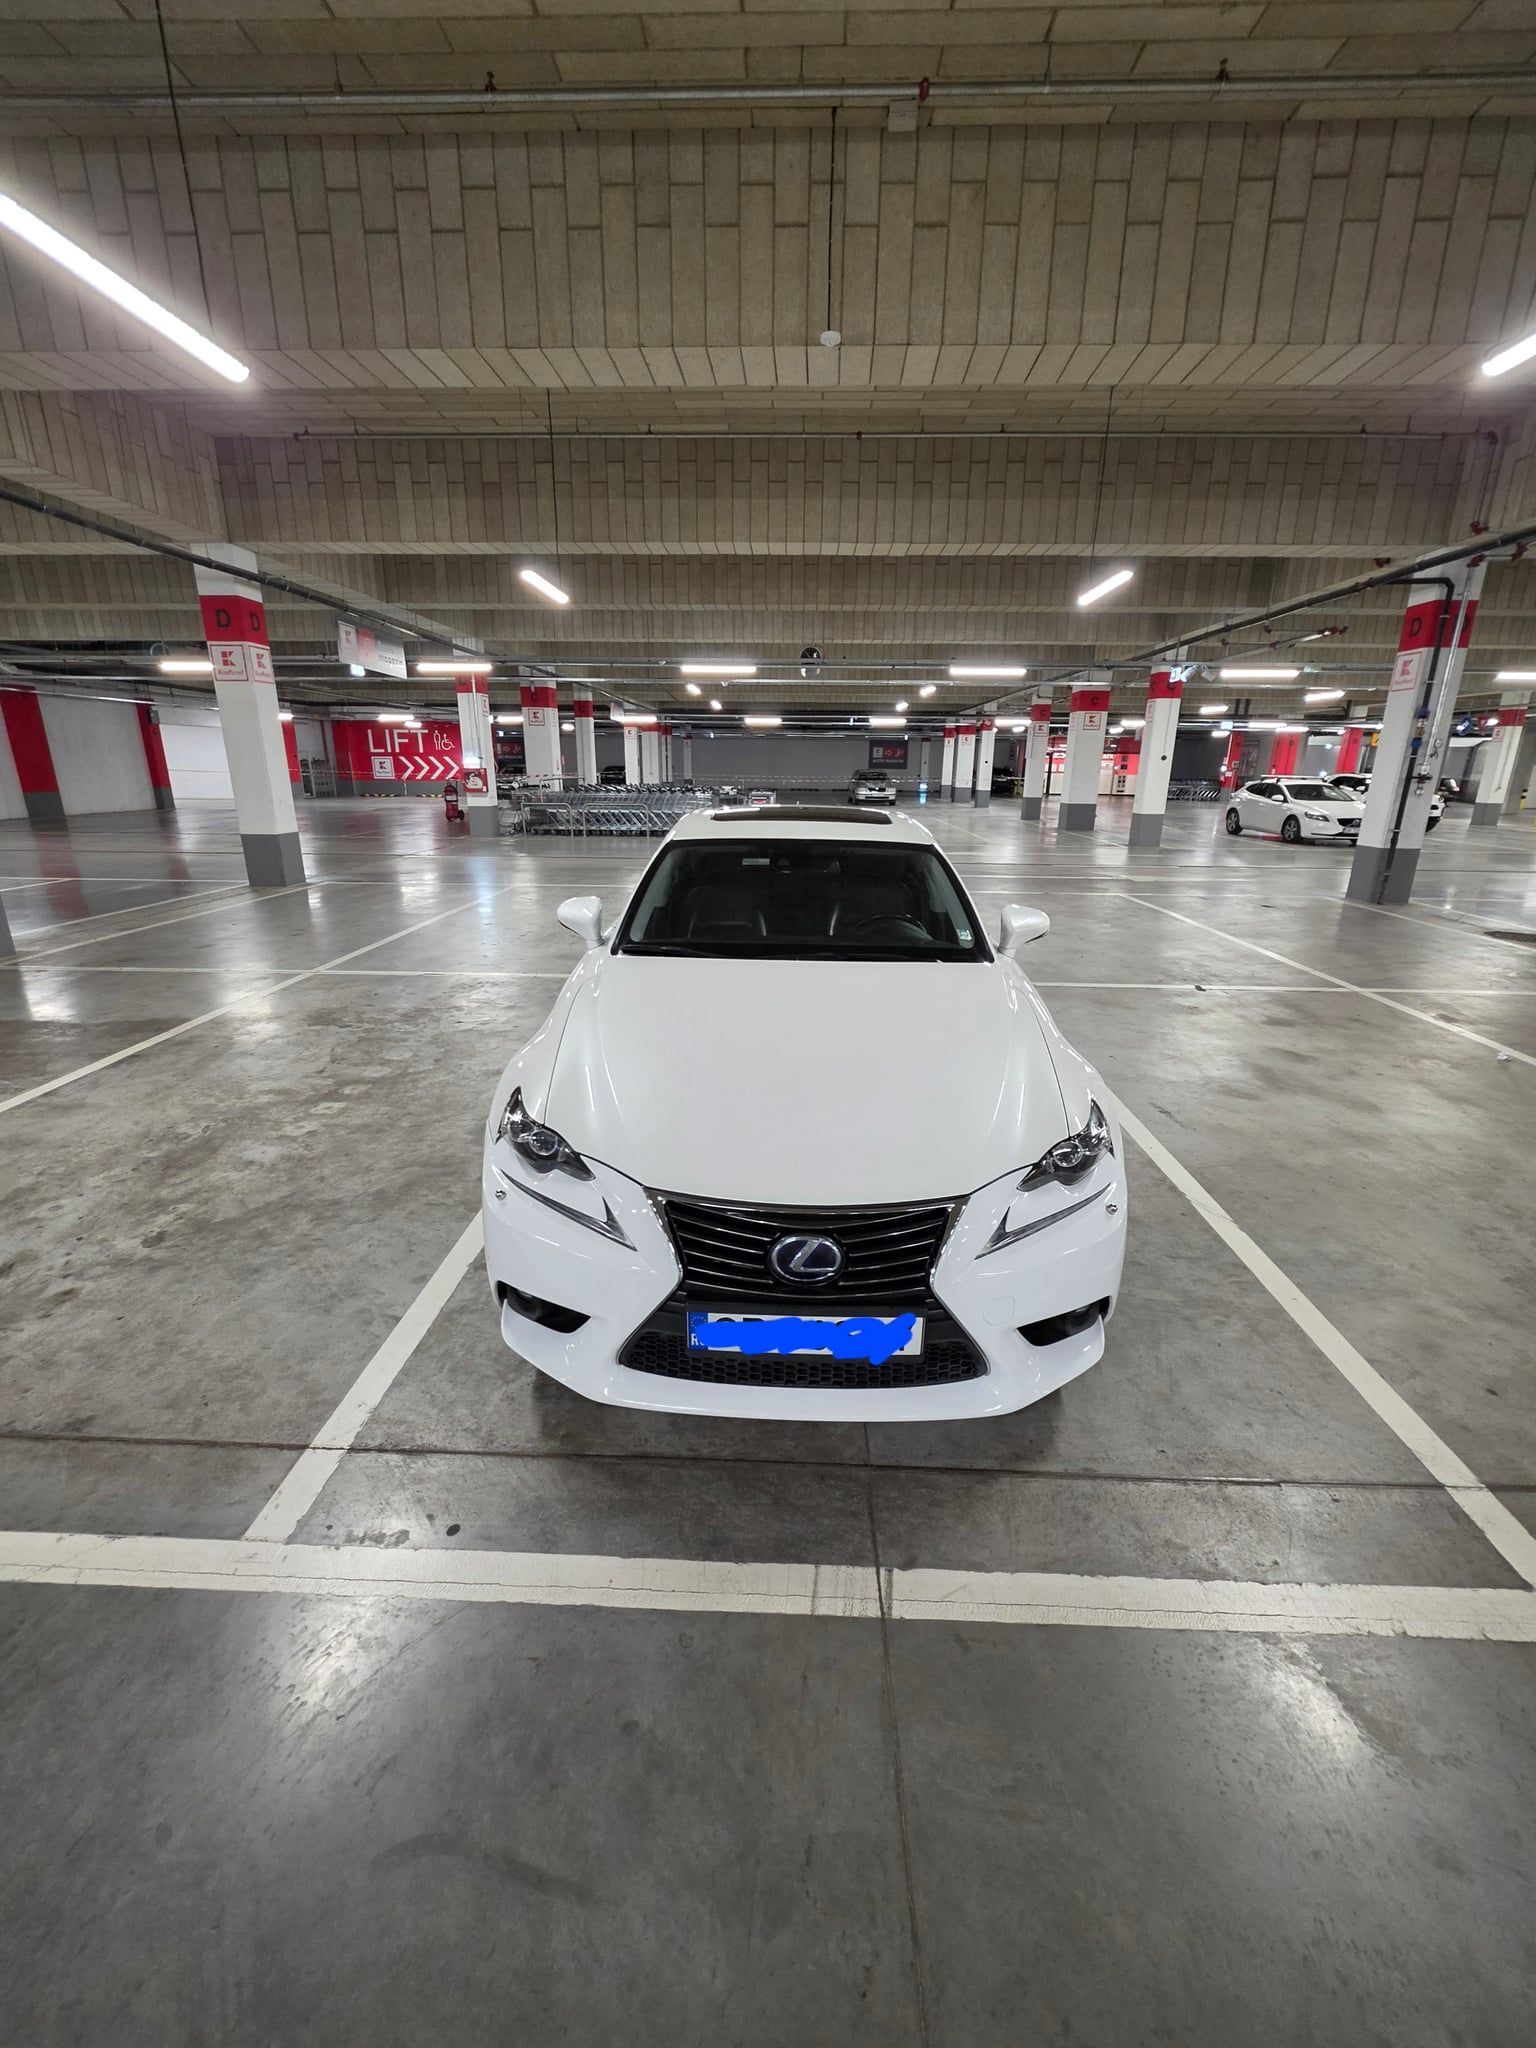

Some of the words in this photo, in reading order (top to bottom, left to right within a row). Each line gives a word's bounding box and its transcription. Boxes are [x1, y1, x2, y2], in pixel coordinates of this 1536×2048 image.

[215, 608, 231, 628] D
[249, 612, 260, 632] D
[1409, 617, 1422, 637] D
[367, 729, 429, 753] LIFT
[691, 1333, 706, 1346] R
